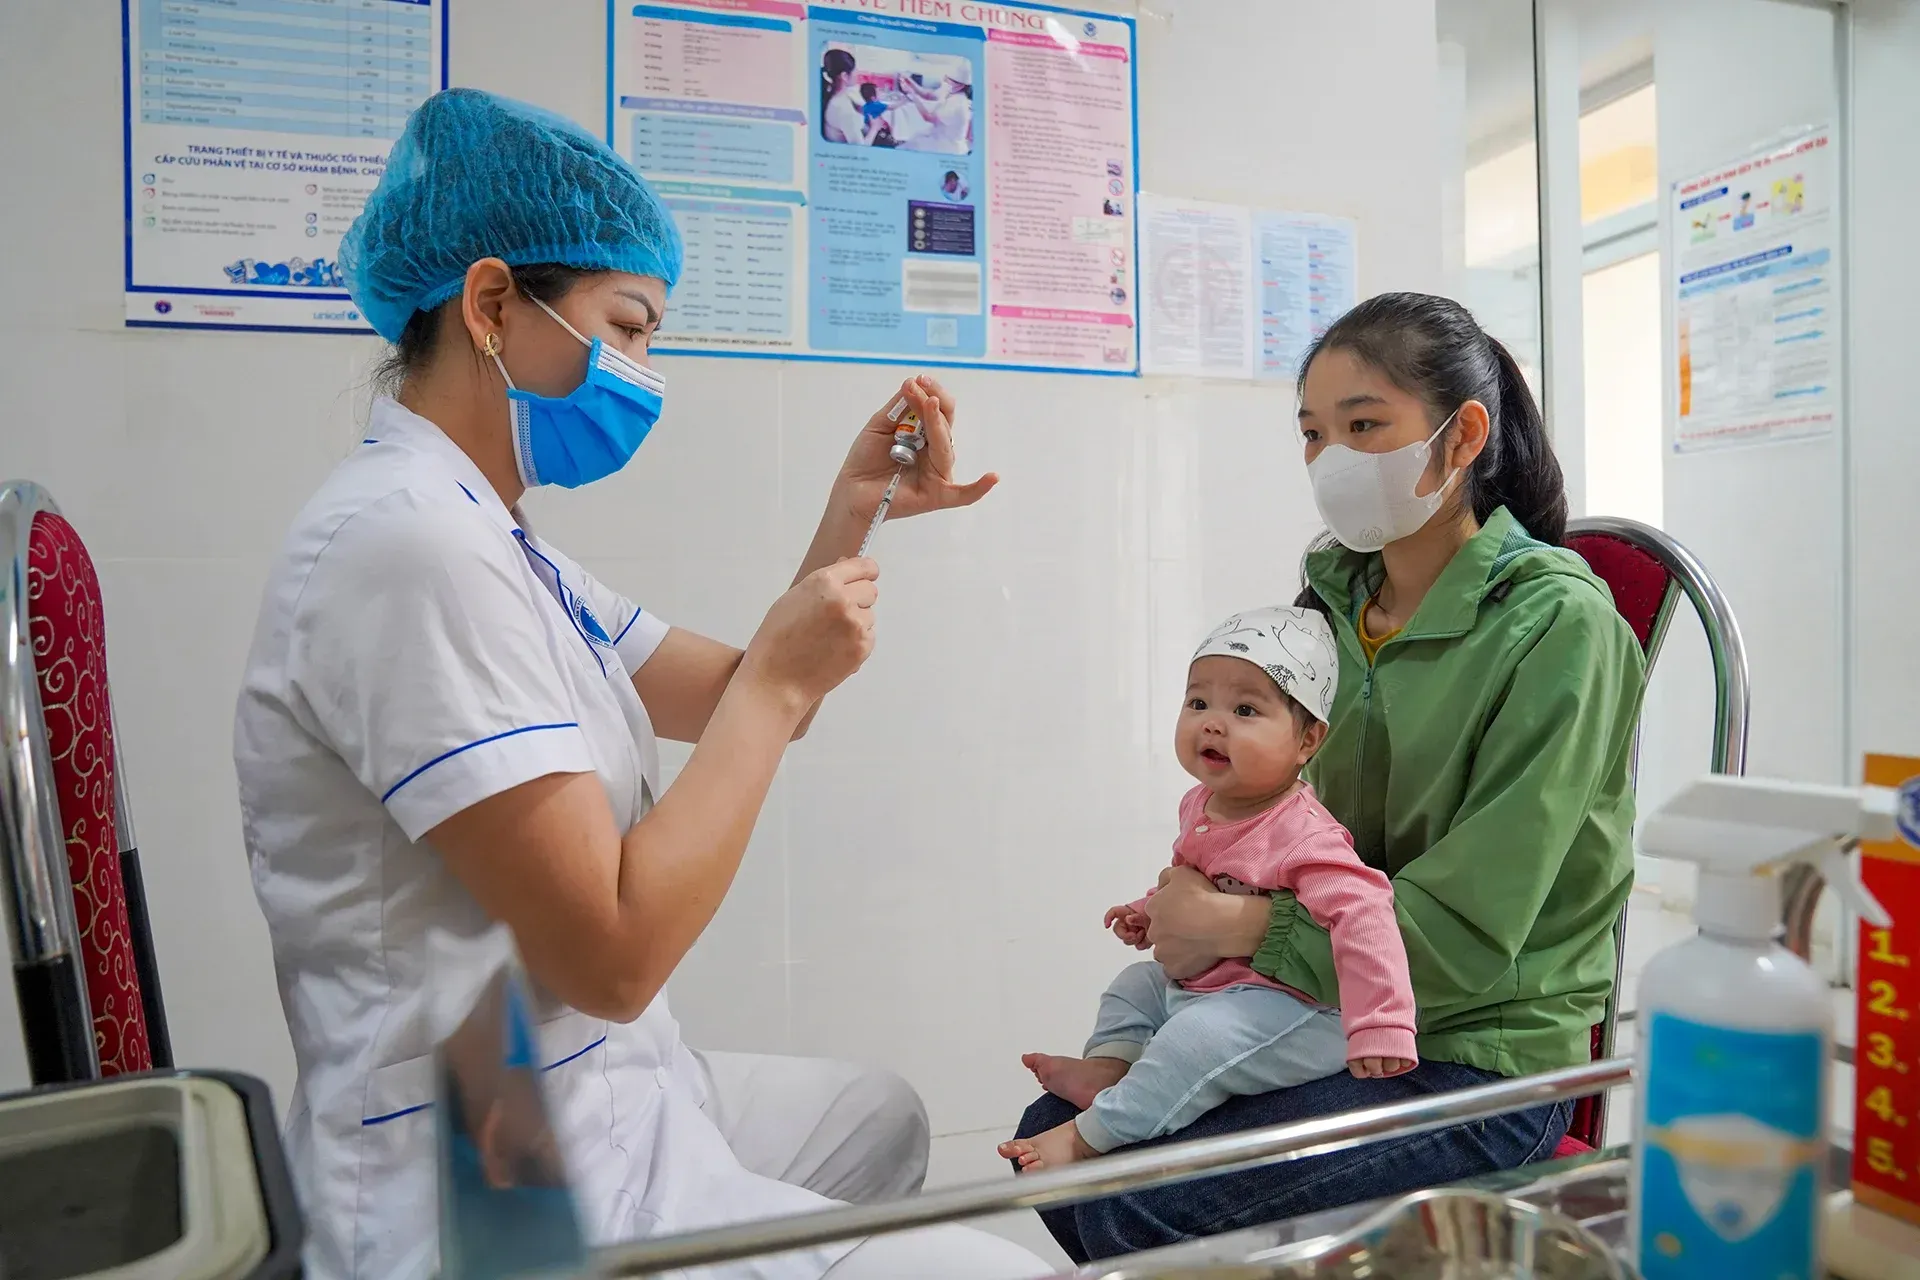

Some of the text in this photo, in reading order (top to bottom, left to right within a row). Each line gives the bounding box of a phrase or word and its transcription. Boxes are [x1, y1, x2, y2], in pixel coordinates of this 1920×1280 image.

[155, 153, 176, 164] CẤP
[298, 164, 328, 174] KHÁM
[188, 145, 223, 155] TRANG
[226, 147, 253, 157] THIẾT
[268, 150, 274, 158] Y
[276, 149, 287, 158] TẾ
[305, 152, 339, 163] THUỐC
[312, 310, 346, 320] unicef
[1868, 929, 1910, 968] 1.
[1867, 979, 1910, 1022] 2.
[1866, 1031, 1909, 1075] 3.
[1864, 1085, 1908, 1128] 4.
[1865, 1135, 1908, 1182] 5.
